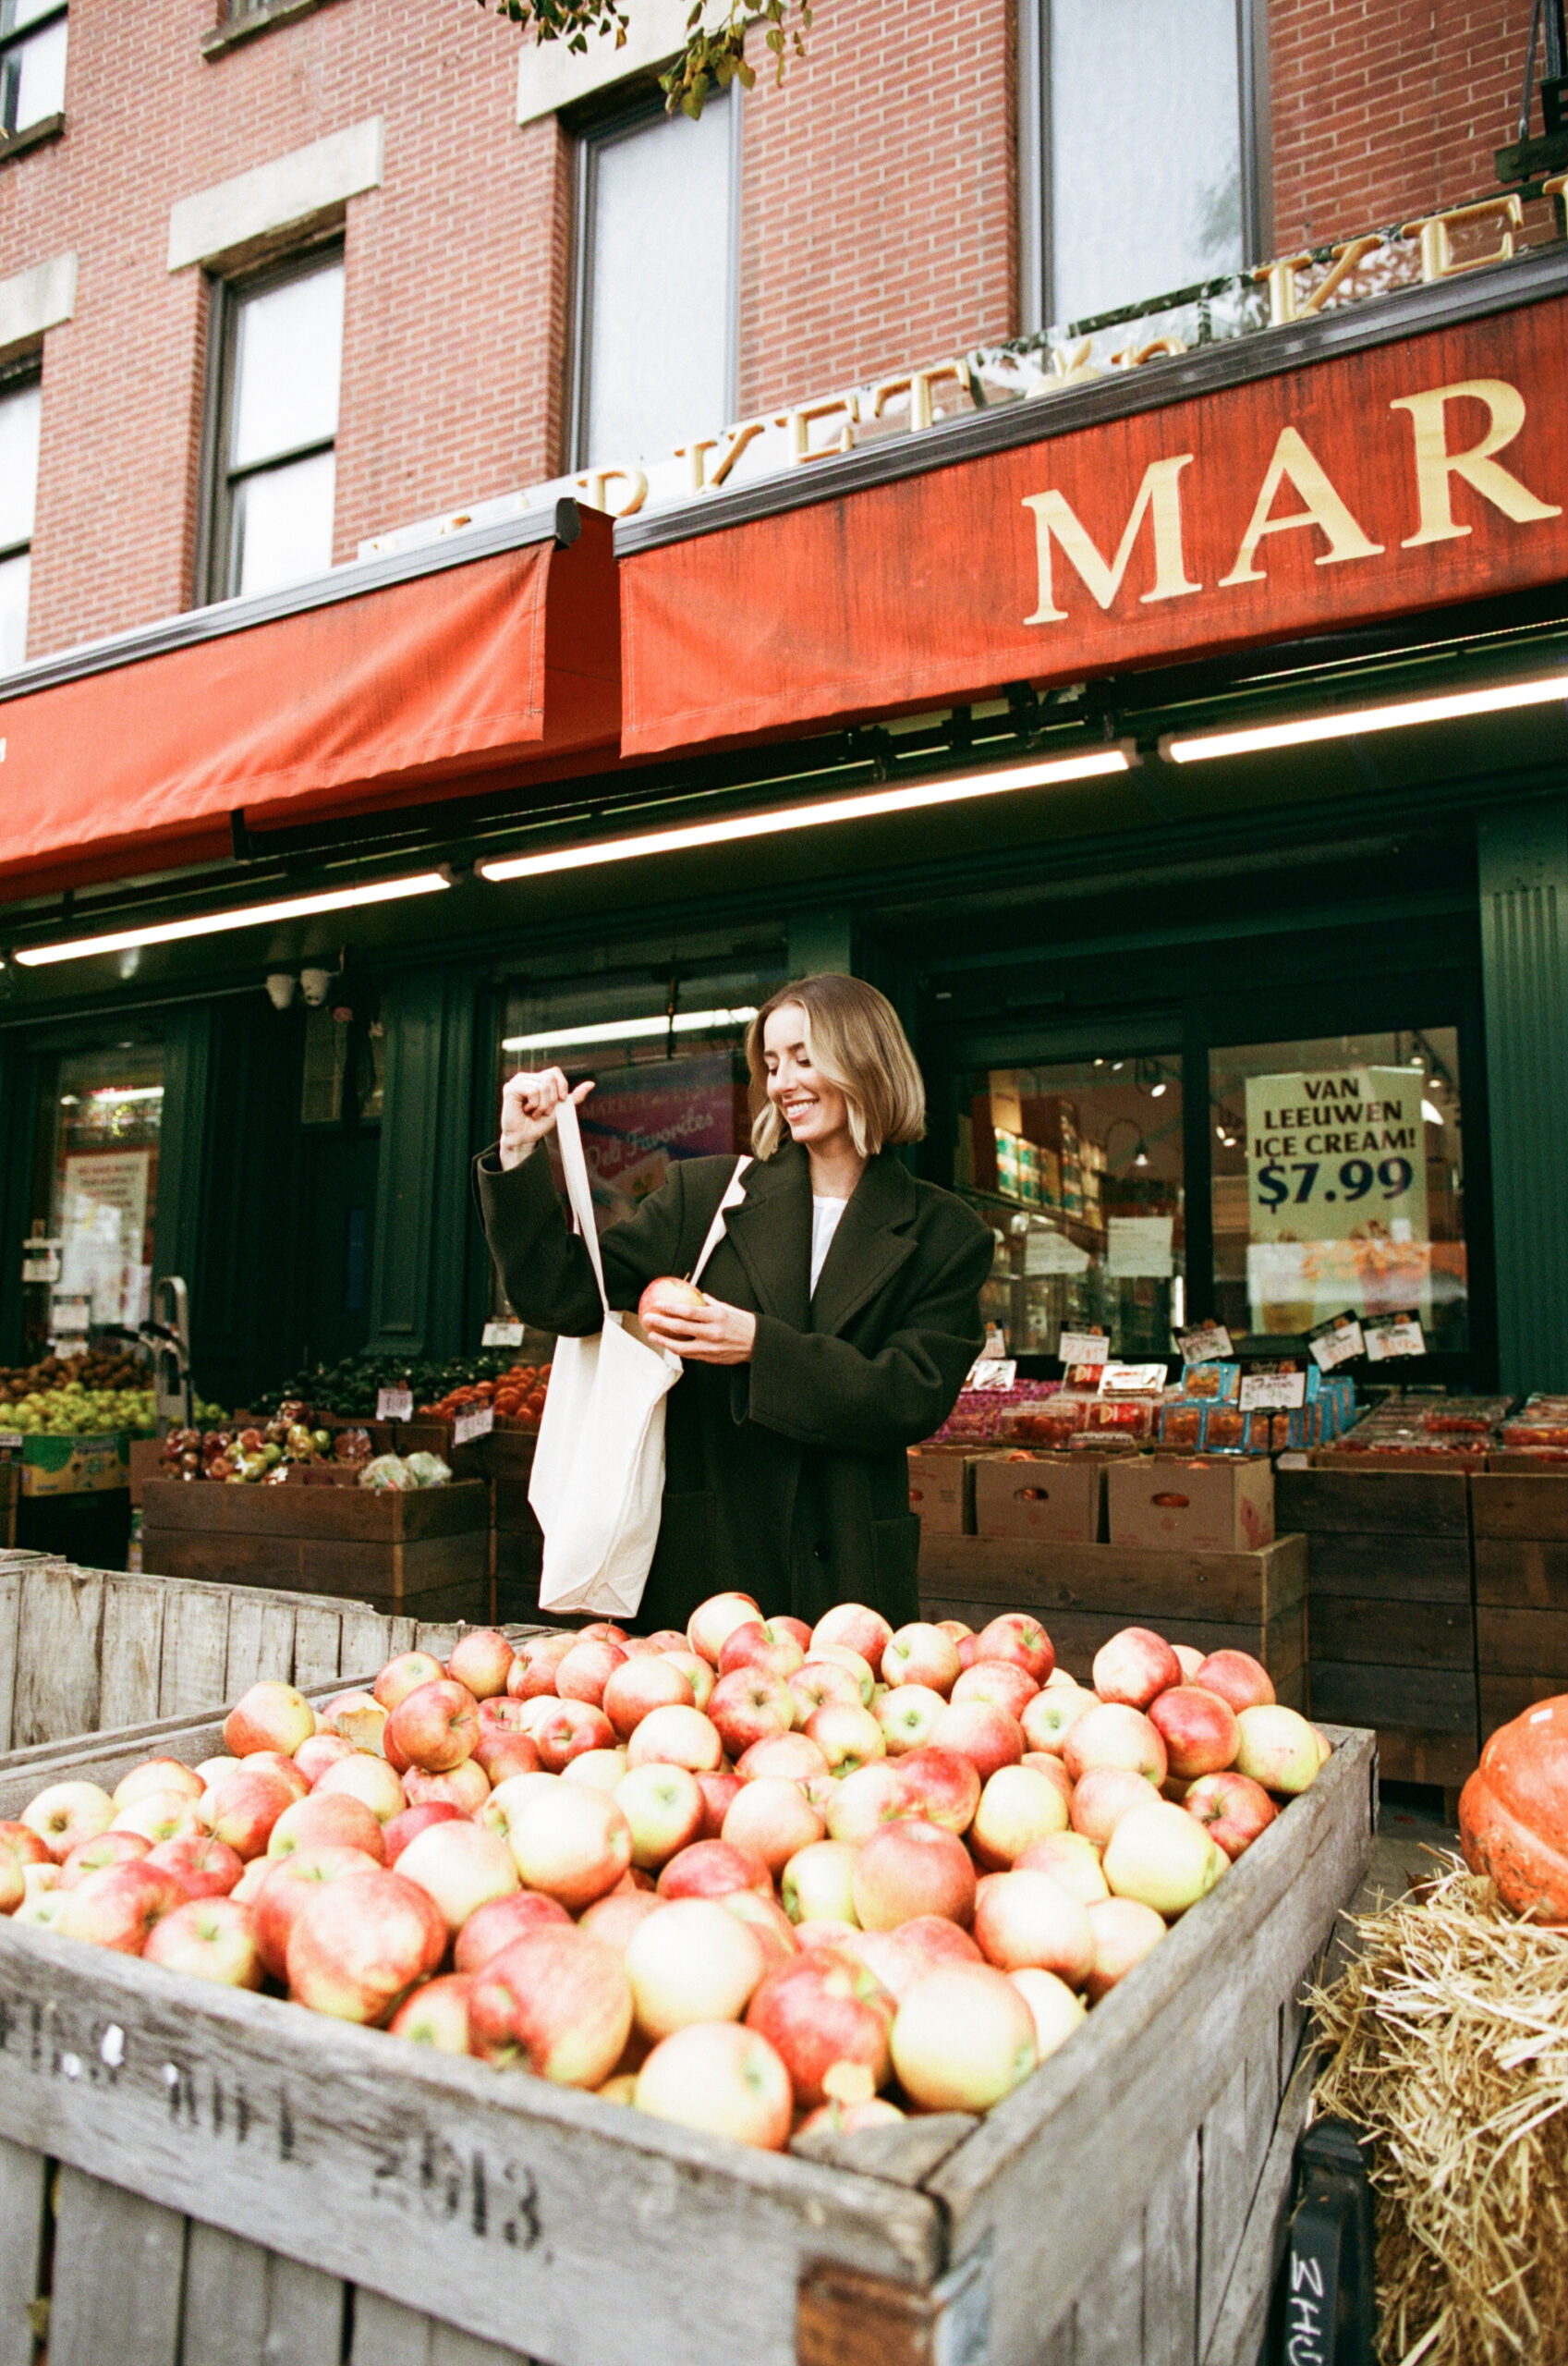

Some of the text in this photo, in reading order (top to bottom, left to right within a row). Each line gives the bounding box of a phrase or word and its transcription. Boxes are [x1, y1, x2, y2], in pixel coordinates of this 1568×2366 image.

[1021, 377, 1562, 627] MAR
[1304, 1077, 1360, 1102] VAN
[1263, 1099, 1403, 1130] LEEUWEN
[1254, 1127, 1416, 1158] ICE CREAM!
[1257, 1157, 1414, 1214] $7.99
